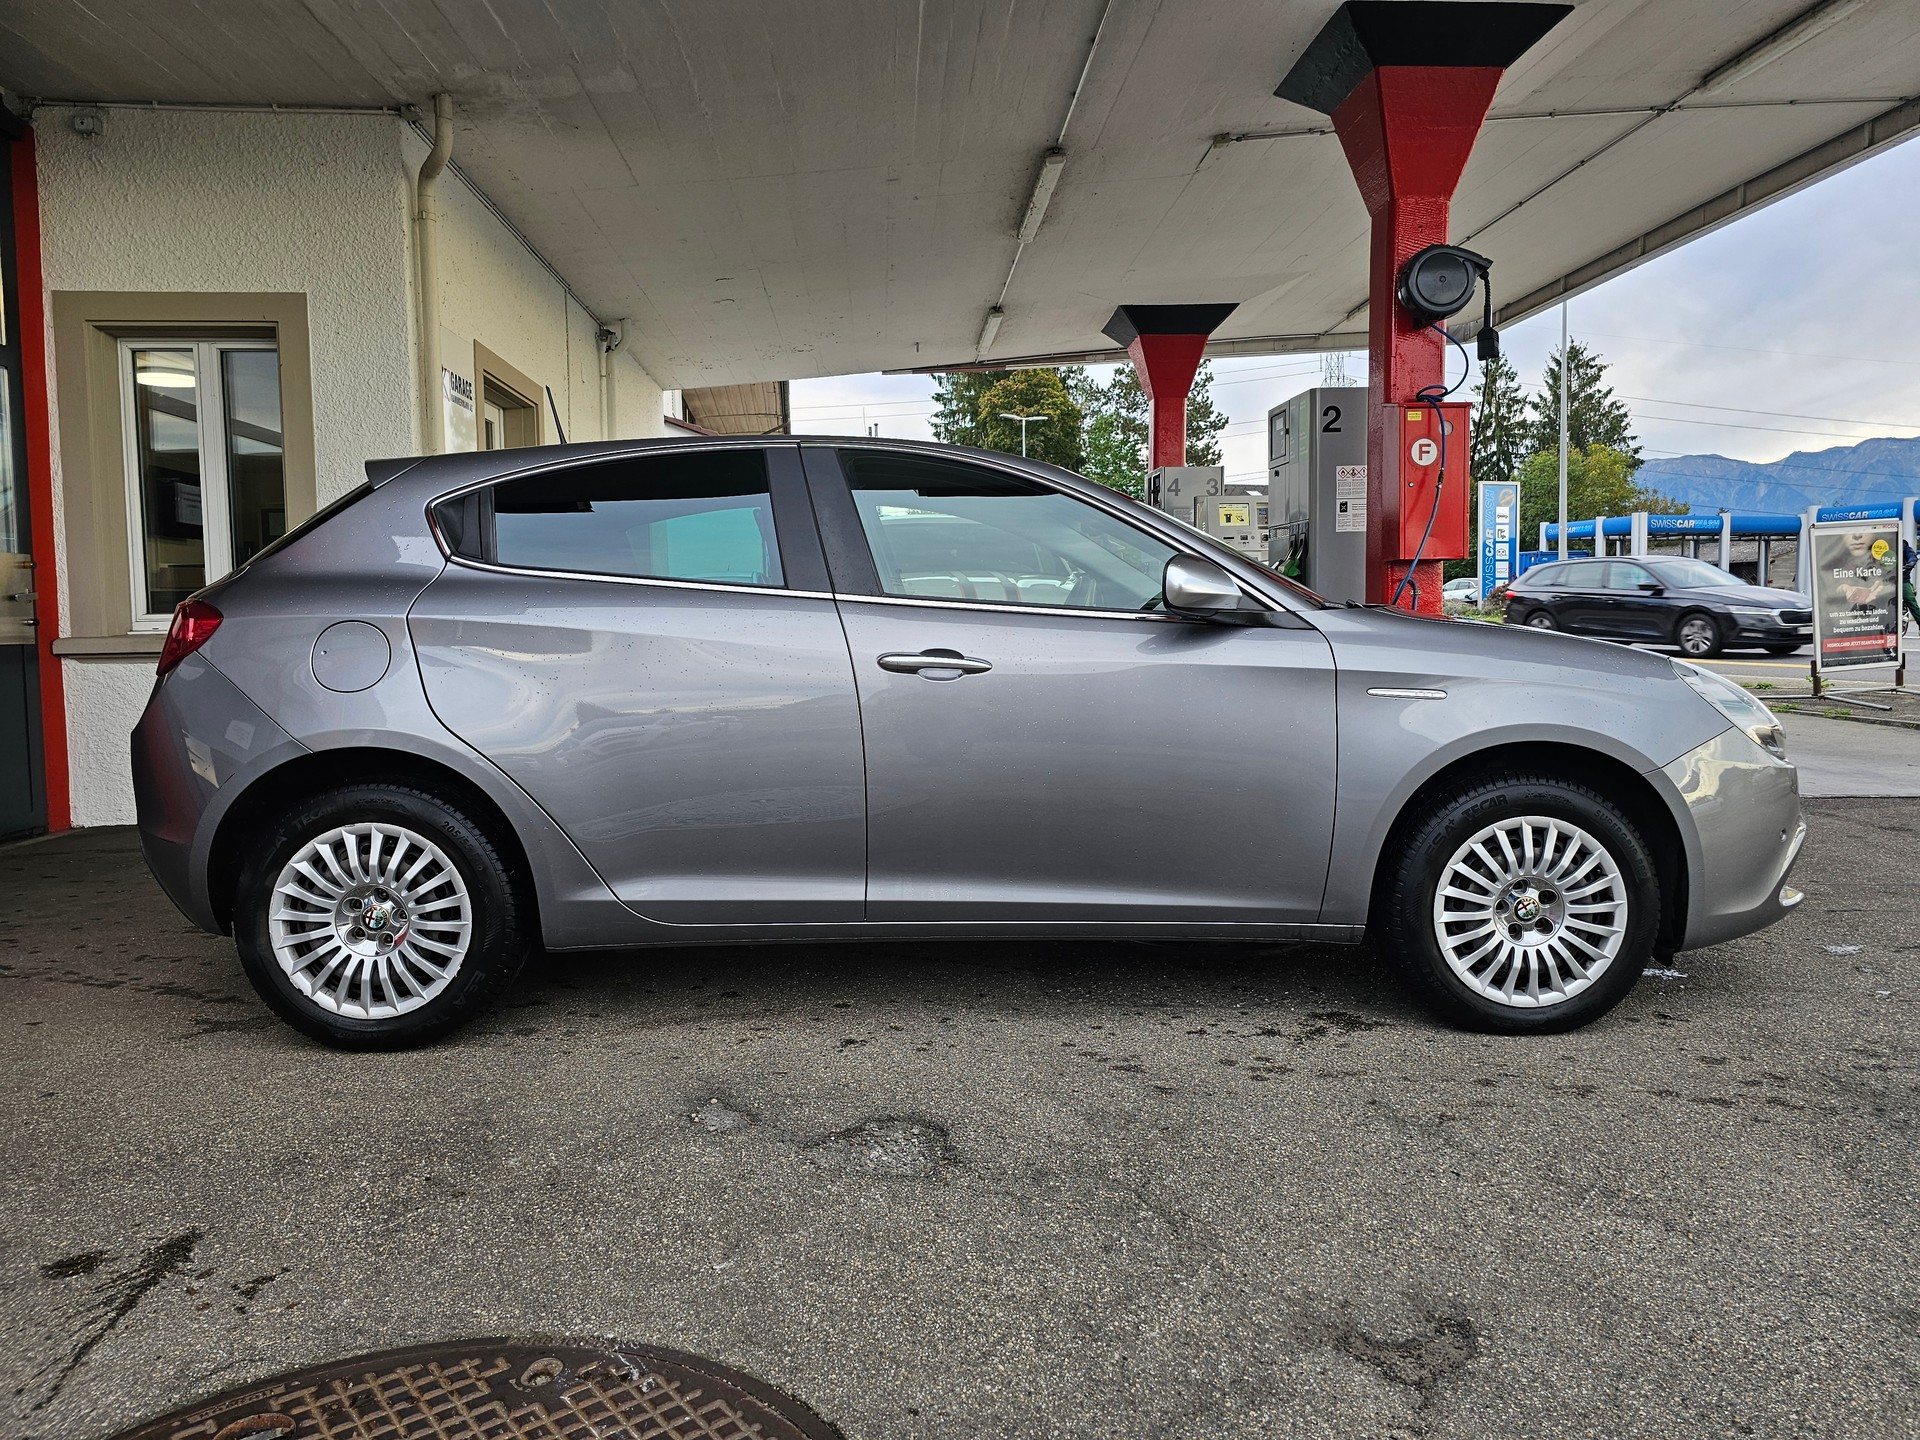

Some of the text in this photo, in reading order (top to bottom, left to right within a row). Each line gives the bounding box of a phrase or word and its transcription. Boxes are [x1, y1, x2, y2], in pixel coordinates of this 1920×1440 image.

[450, 371, 473, 401] GARAGE
[1321, 404, 1342, 433] 2
[1418, 443, 1432, 461] F
[1166, 478, 1181, 497] 4
[1205, 478, 1219, 497] 3
[1833, 567, 1882, 579] Eine Karte
[1845, 609, 1865, 617] tanken,
[1872, 608, 1888, 616] laden,
[1833, 626, 1854, 634] bequem
[1860, 624, 1885, 632] bezahlen.
[1461, 793, 1509, 821] TECAR
